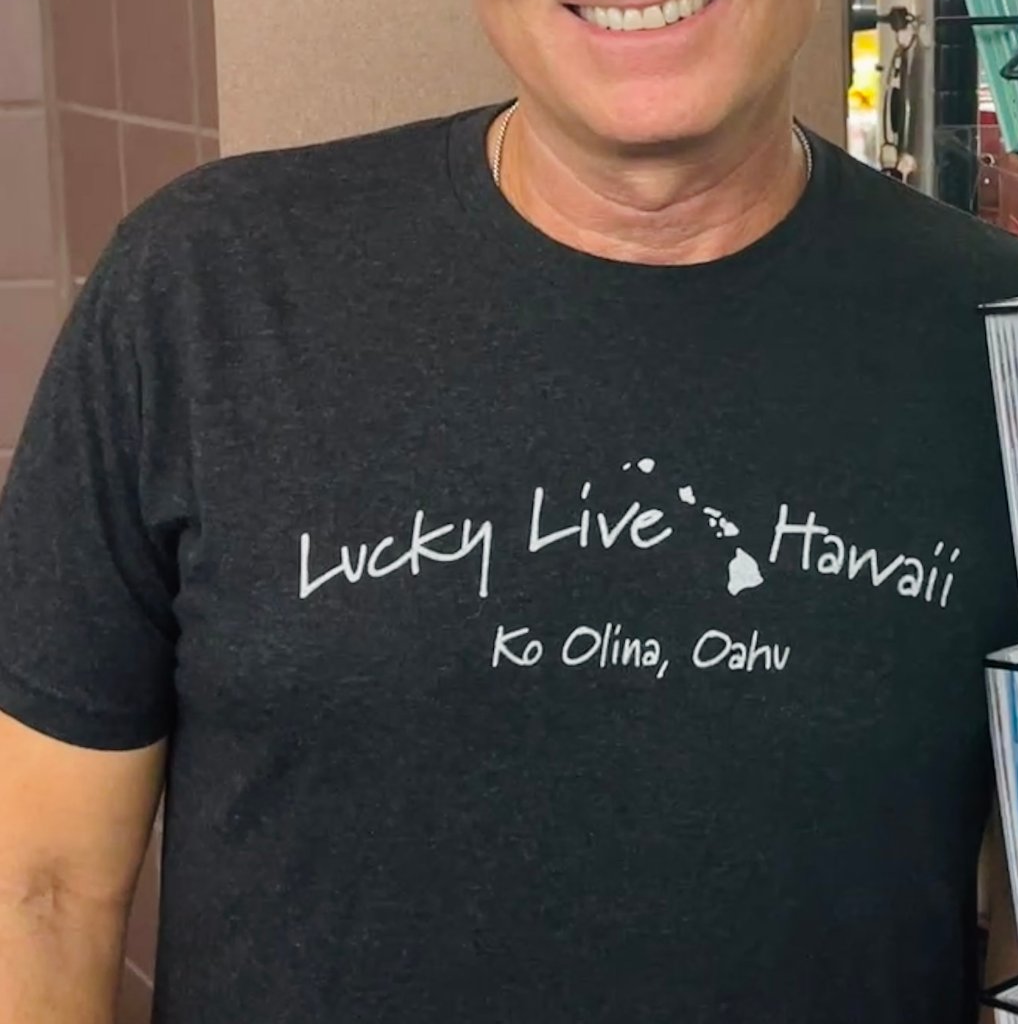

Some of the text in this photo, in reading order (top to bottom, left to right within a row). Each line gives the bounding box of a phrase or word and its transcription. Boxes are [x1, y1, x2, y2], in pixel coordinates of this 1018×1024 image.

[300, 483, 959, 607] Lucky Live Hawaii
[492, 623, 790, 678] Ko Olina, Oahu
